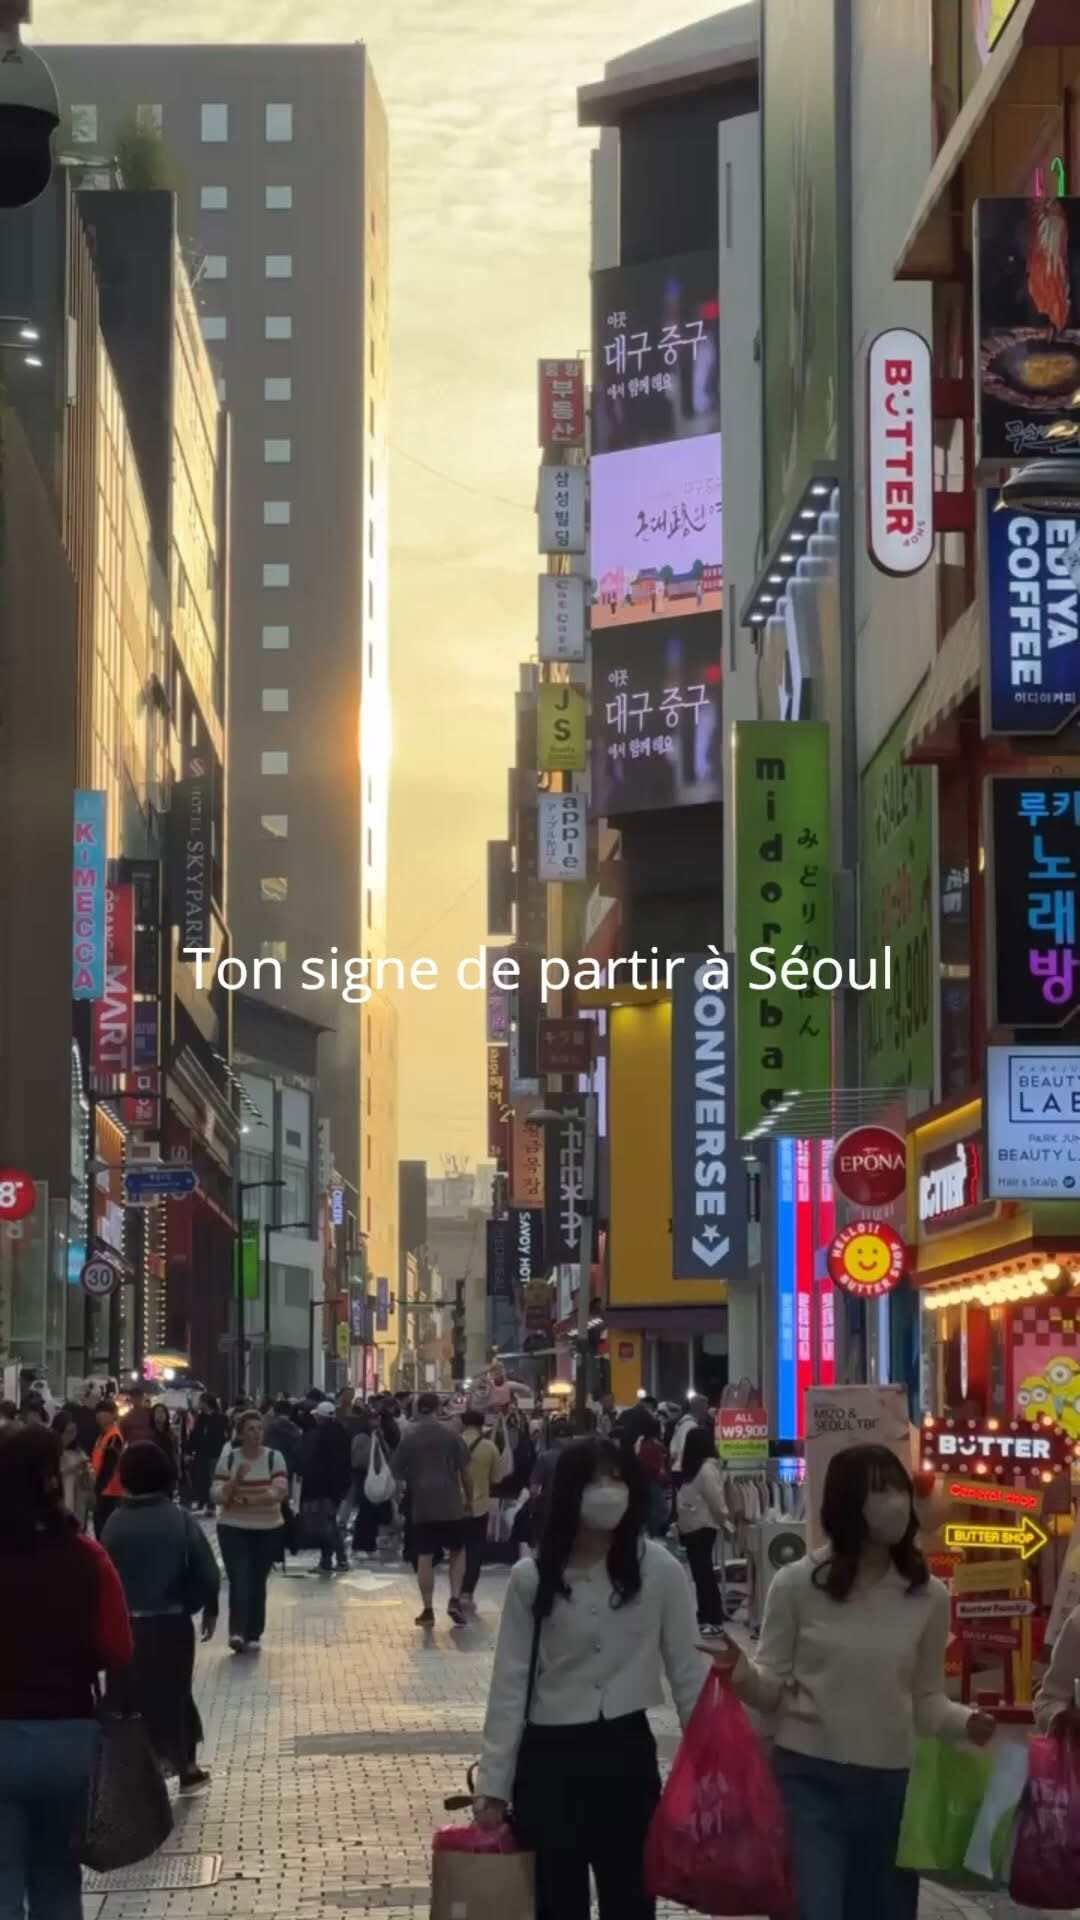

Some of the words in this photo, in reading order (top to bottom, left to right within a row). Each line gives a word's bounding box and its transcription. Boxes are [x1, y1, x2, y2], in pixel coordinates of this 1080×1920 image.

[603, 331, 652, 375] 대구
[657, 319, 708, 365] 중구
[551, 380, 575, 442] 부동산
[554, 471, 570, 547] 삼성빌딩
[1008, 516, 1042, 686] COFFEE
[606, 691, 653, 734] 대구
[659, 684, 710, 728] 중구
[1014, 691, 1076, 704] 이디야커피
[185, 841, 204, 949] SKYPARK
[1028, 835, 1080, 1004] 노래방
[101, 964, 129, 1071] MART
[694, 963, 726, 1216] CONVERSE
[841, 1155, 906, 1173] EPONA
[998, 1148, 1062, 1161] BEAUTY
[87, 1269, 110, 1287] 30
[734, 1413, 753, 1423] ALL
[954, 1530, 999, 1542] BUTTER
[1001, 1532, 1034, 1543] SHOP
